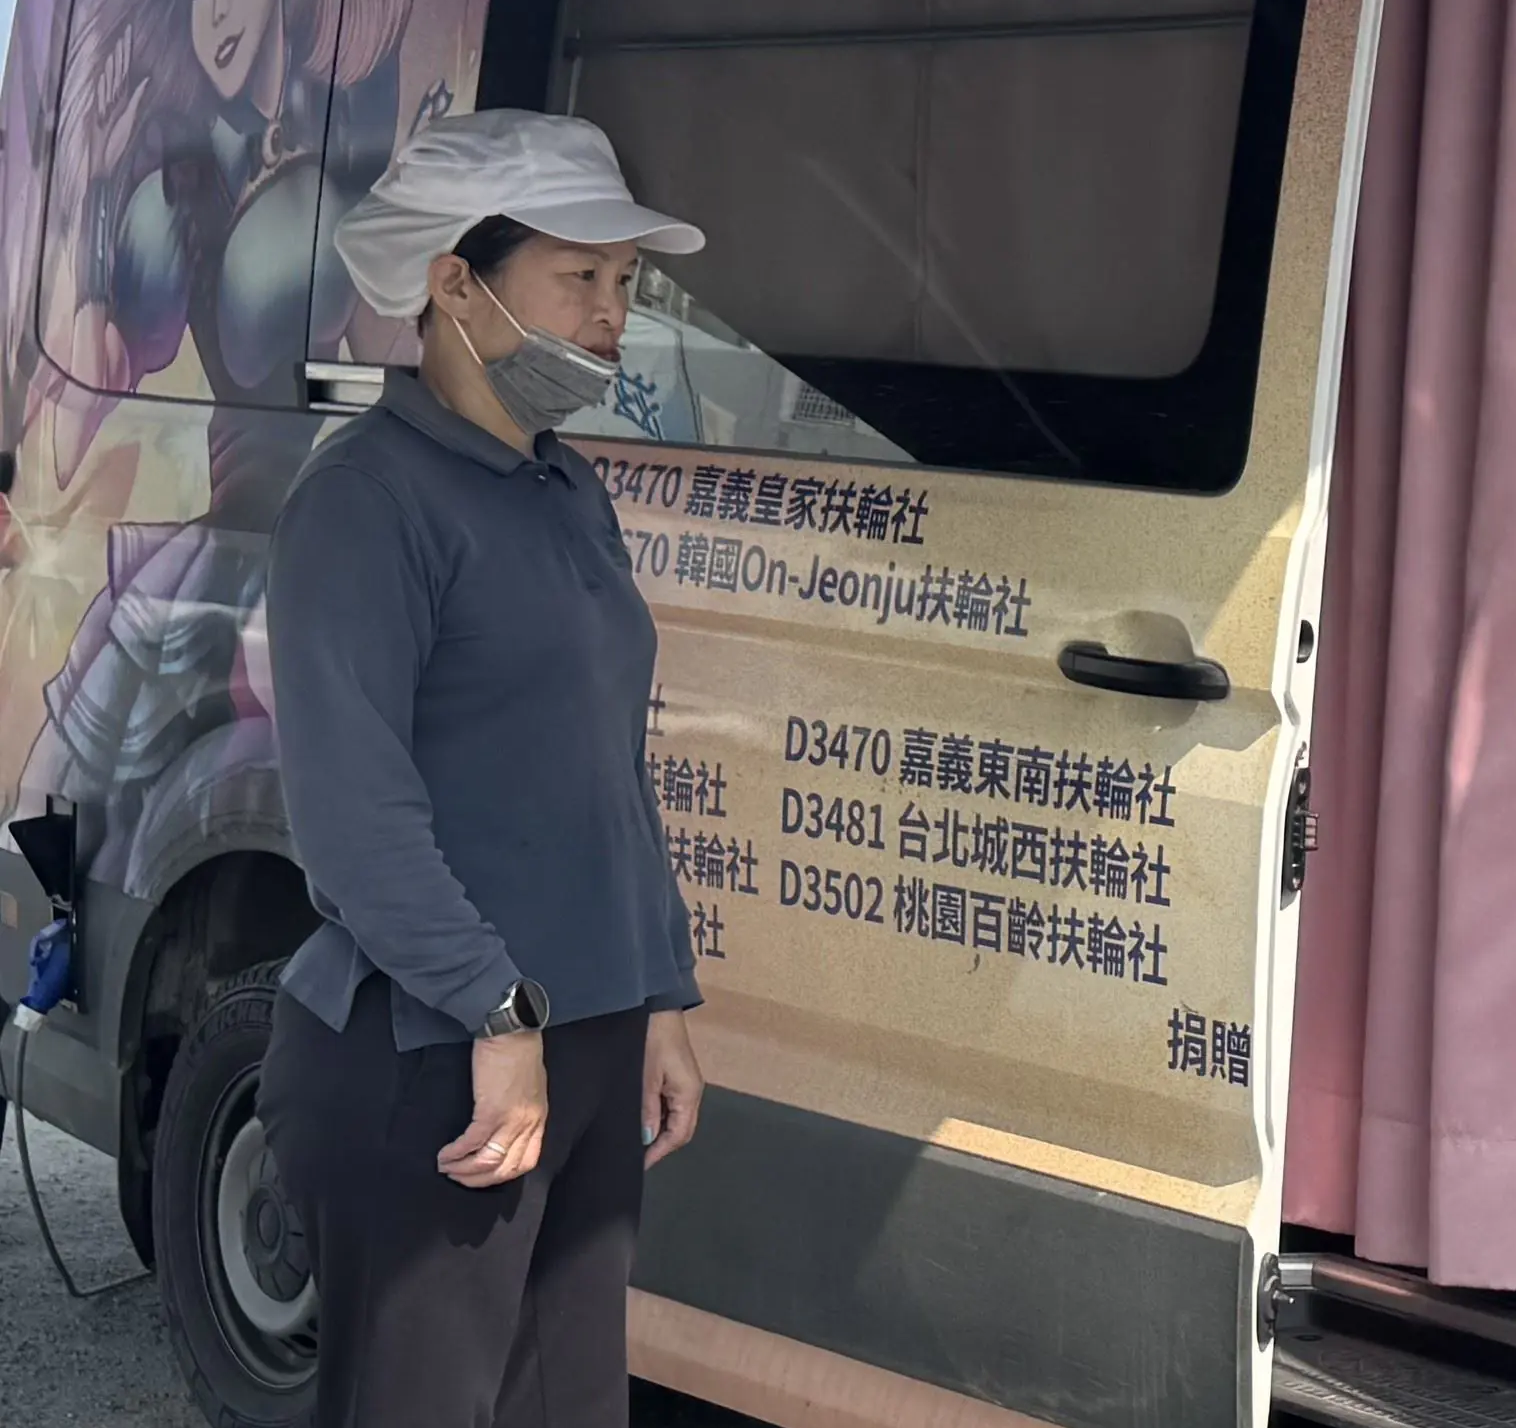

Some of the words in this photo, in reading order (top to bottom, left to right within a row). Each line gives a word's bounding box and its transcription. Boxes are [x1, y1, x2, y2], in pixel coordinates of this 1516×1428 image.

[593, 456, 683, 508] D3470
[683, 464, 929, 546] 嘉義皇家扶輪社
[674, 530, 1032, 638] 韓國On-Jeonju扶輪社
[784, 715, 891, 776] D3470
[899, 727, 1177, 827] 嘉義東南扶輪社
[781, 787, 886, 850] D3481
[897, 801, 1171, 907] 台北城西扶輪社
[780, 859, 885, 925] D3502
[893, 874, 1168, 986] 桃園百齡扶輪社
[1167, 1007, 1251, 1087] 捐贈
